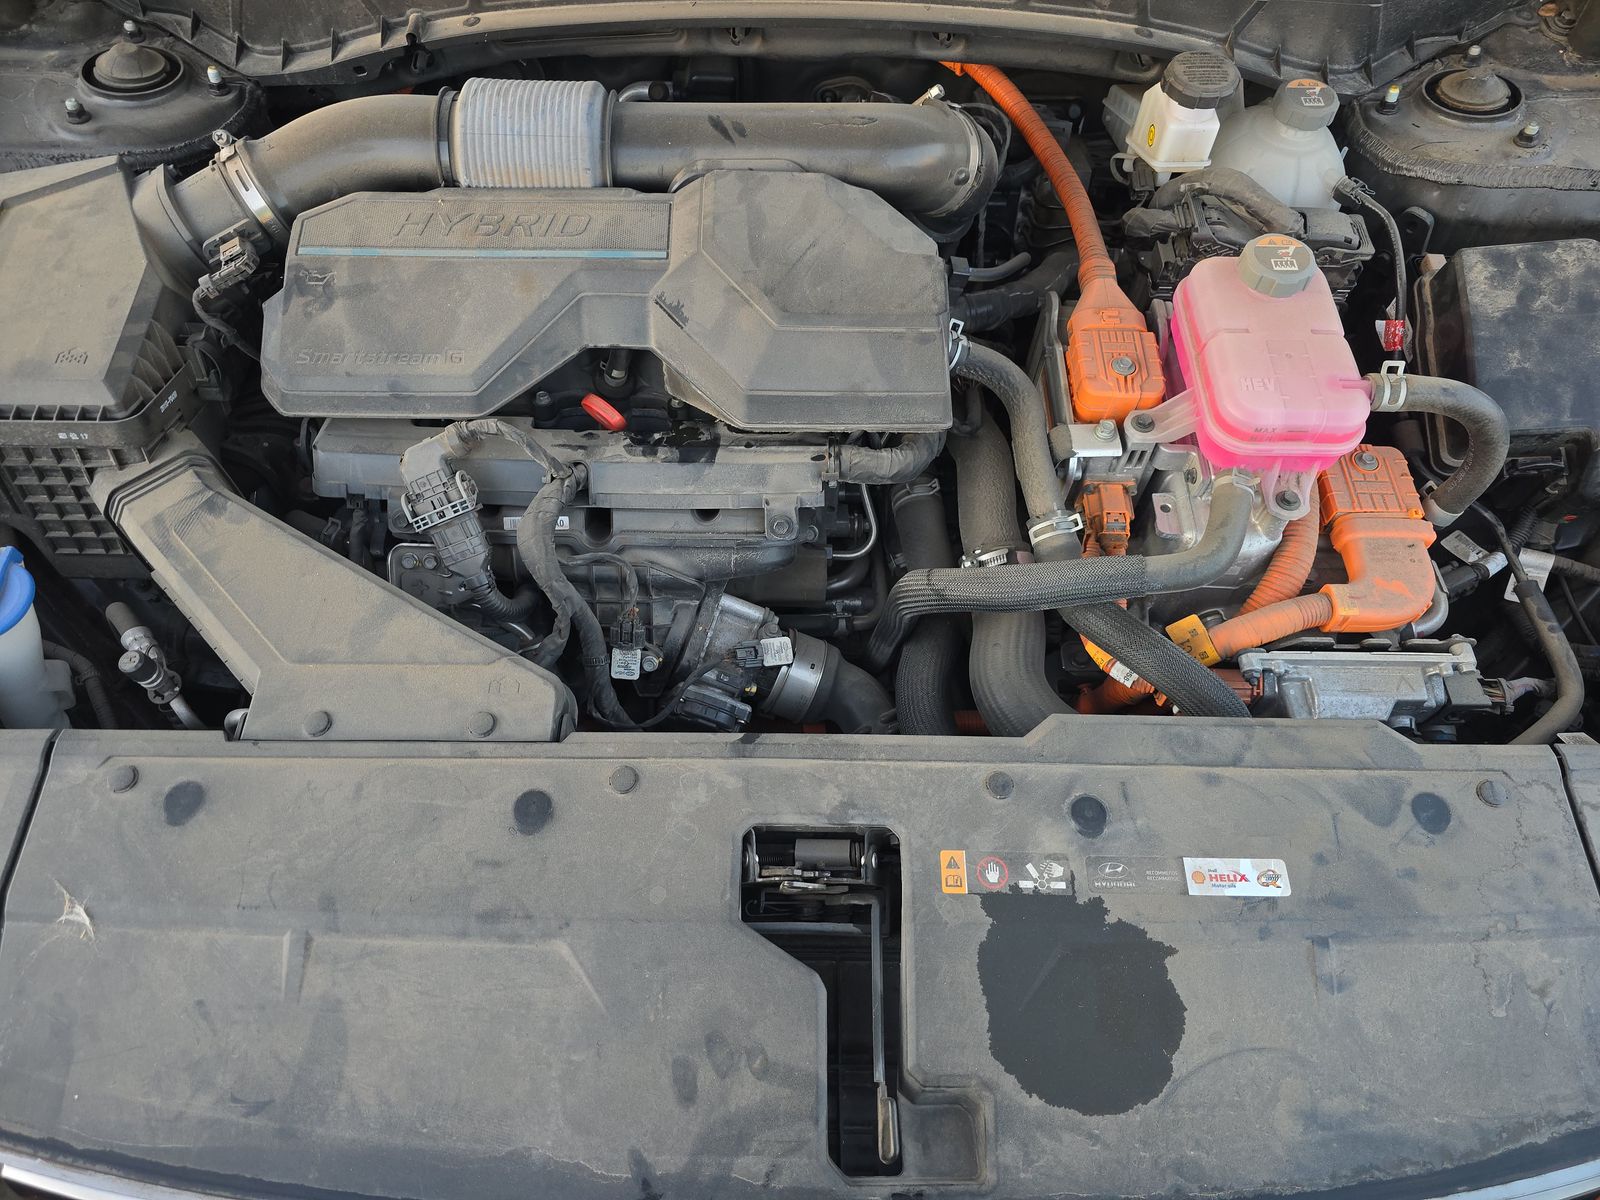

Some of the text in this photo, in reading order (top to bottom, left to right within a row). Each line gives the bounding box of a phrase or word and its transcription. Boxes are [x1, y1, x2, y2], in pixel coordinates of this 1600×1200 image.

[394, 212, 592, 237] HYBRID
[296, 349, 441, 365] Smartstream
[1208, 872, 1251, 883] HELIX
